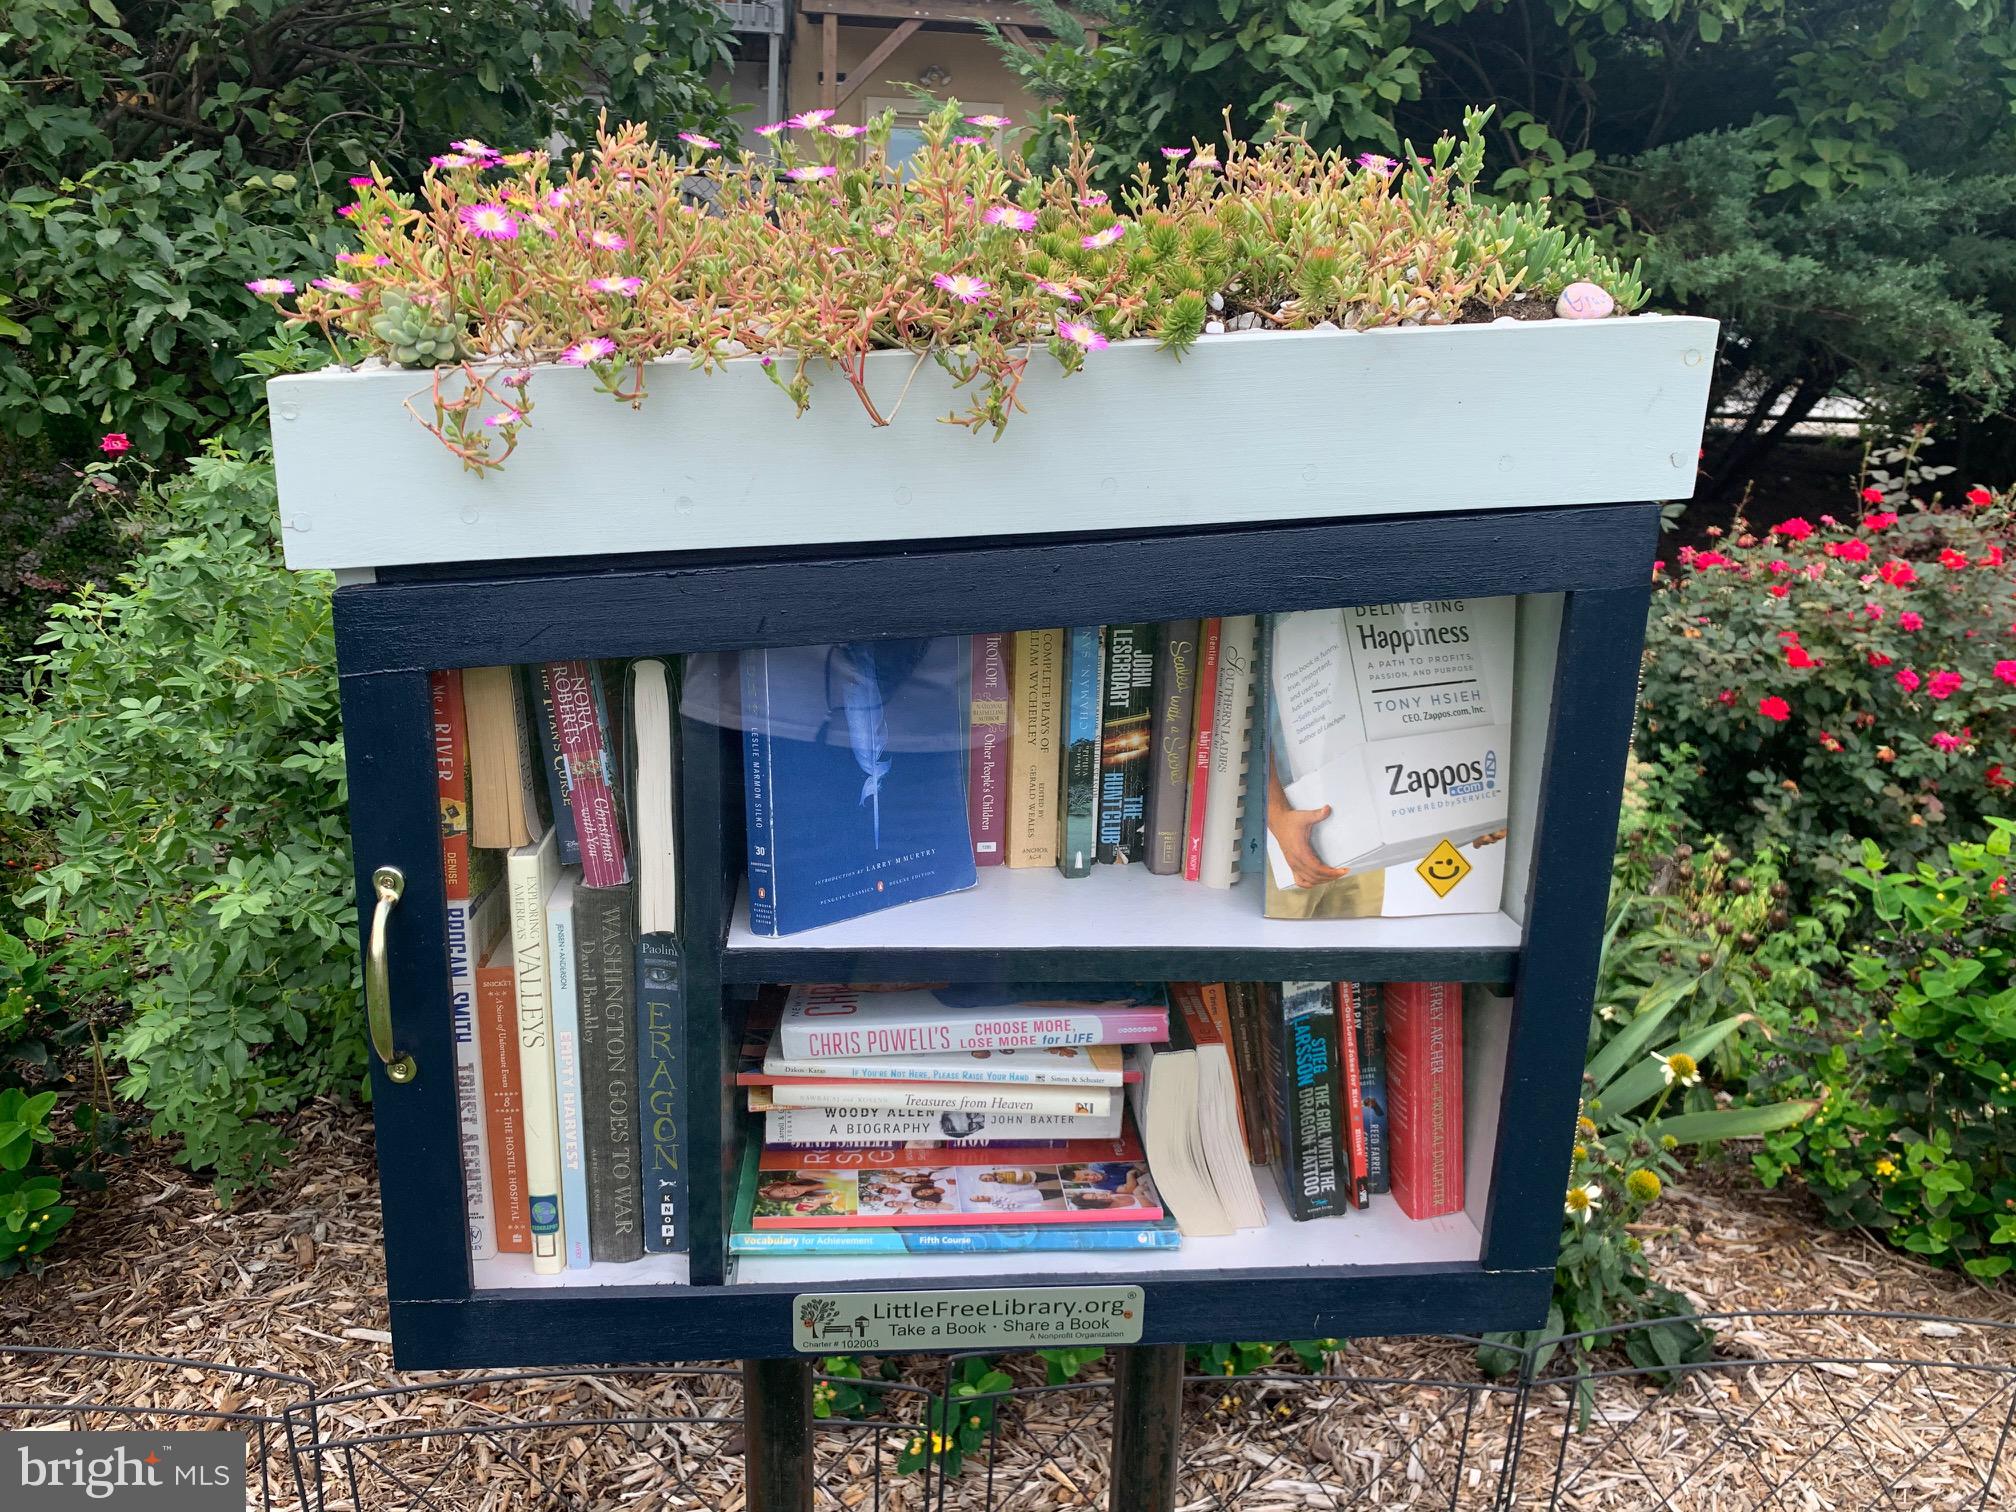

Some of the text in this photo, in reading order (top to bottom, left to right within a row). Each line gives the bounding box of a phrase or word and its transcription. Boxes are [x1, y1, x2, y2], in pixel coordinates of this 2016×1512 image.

[1355, 600, 1465, 617] DELIVERING
[1356, 621, 1470, 655] Happiness
[985, 636, 1002, 688] TROLLOPE
[1109, 629, 1134, 708] LESCROART
[1131, 649, 1153, 689] JOHN
[1367, 662, 1374, 670] A
[1378, 659, 1405, 668] PATH
[1409, 657, 1424, 665] TO
[1413, 668, 1431, 677] AND
[1434, 665, 1474, 674] PURPOSE
[552, 666, 581, 744] ROBERTS
[570, 677, 594, 731] NORA
[1027, 671, 1038, 746] WYCHERLEY
[1040, 633, 1053, 753] COMPLETE PLAYS OF
[1167, 695, 1182, 723] with
[1216, 645, 1247, 774] SOUTHERN LADIES
[1374, 690, 1481, 713] TONY HSIEH
[984, 733, 996, 760] Other
[750, 727, 763, 828] LESLIE MARMON SILKO
[981, 762, 996, 793] People's
[1102, 772, 1124, 807] HUNT
[1384, 760, 1483, 798] Zappos
[982, 794, 995, 831] Children
[1027, 765, 1037, 839] GERALD WEALES
[1122, 794, 1144, 821] THE
[581, 807, 600, 857] with You
[594, 797, 614, 863] Christmas
[1100, 810, 1121, 845] CLUB
[447, 852, 458, 885] DENISE
[866, 859, 892, 872] LARRY
[526, 875, 541, 941] EXPLORING
[555, 923, 568, 990] JENSEN ANDERSON
[518, 942, 546, 1048] VALLEYS
[580, 942, 600, 1044] David Brinkley
[974, 1019, 1077, 1036] CHOOSE MORE,
[1343, 983, 1355, 1046] augh-Out-Loud
[809, 1025, 951, 1057] CHRIS POWELL'S
[960, 1032, 1095, 1050] LOSE MORE for LIFE
[1292, 1013, 1315, 1088] LARSSON
[1310, 1037, 1328, 1075] STIEG
[1430, 1027, 1445, 1075] ARCHER
[601, 907, 634, 1236] WASHINGTON GOES TO WAR
[1348, 1048, 1357, 1072] Jokes
[646, 1001, 680, 1171] ERAGON
[1050, 1075, 1070, 1083] Simon
[1079, 1076, 1105, 1084] Schuster
[1314, 1083, 1330, 1109] THE
[559, 1031, 579, 1170] EMPTY HARVEST
[825, 1107, 1075, 1125] WOODY ALLEN JOHN BAXTER
[904, 1093, 957, 1108] Treasures
[959, 1096, 988, 1112] from
[991, 1097, 1034, 1111] Heaven
[1351, 1088, 1359, 1109] Kids
[829, 1122, 931, 1135] A BIOGRAPHY
[1298, 1086, 1317, 1148] DRAGON
[1315, 1109, 1332, 1137] GIRL
[504, 1115, 520, 1221] THE HOSTILE HOSPITAL
[1317, 1136, 1335, 1170] WITH
[1369, 1124, 1381, 1177] REED FARREL
[1301, 1146, 1320, 1197] TATTOO
[1319, 1170, 1336, 1194] THE
[1432, 1149, 1445, 1207] DAUGHTER
[660, 1194, 675, 1245] KNOPF
[744, 1235, 972, 1247] Vocabulary for Achievement Fifth Course
[874, 1297, 1125, 1320] LittleFreeLibrary.org
[889, 1316, 1110, 1336] Take a Book Share a Book
[802, 1339, 879, 1349] Charter # 102003
[1037, 1331, 1074, 1340] Nonprofit
[1075, 1330, 1124, 1340] Organization
